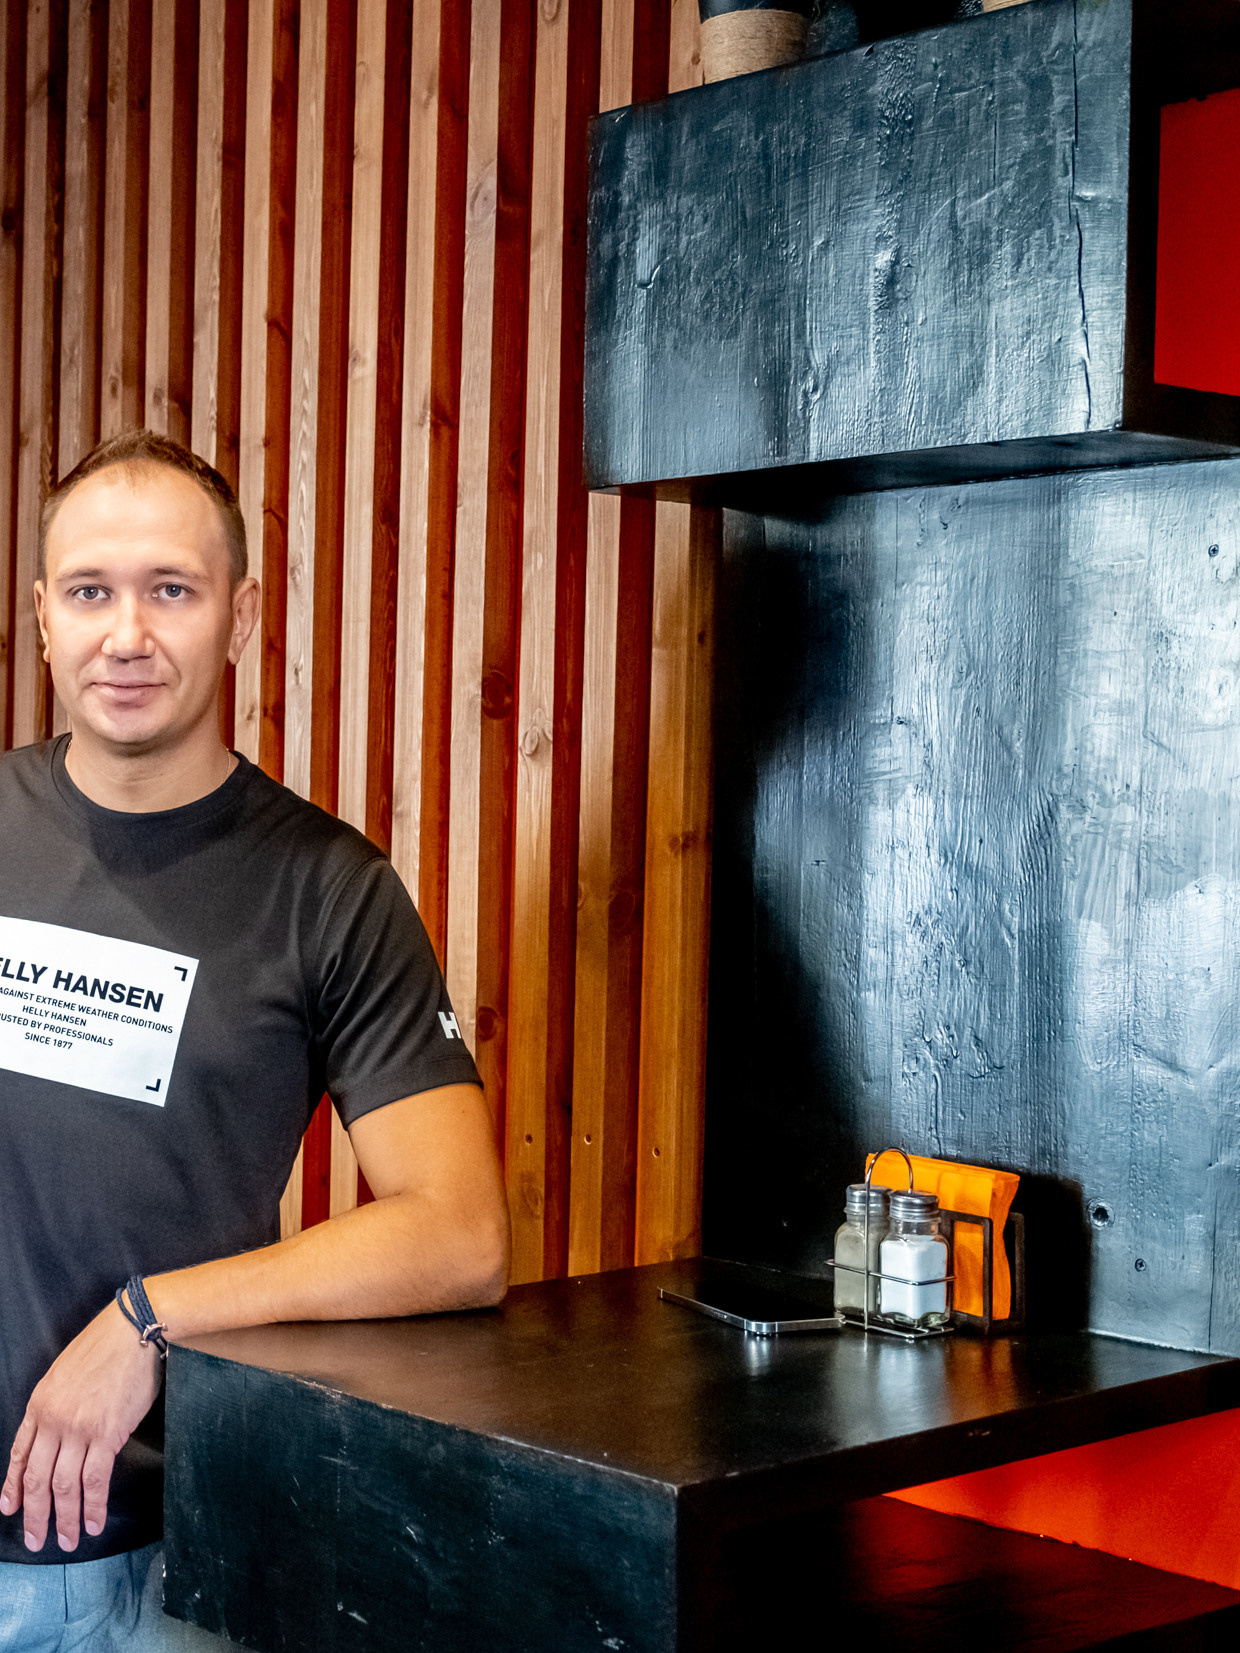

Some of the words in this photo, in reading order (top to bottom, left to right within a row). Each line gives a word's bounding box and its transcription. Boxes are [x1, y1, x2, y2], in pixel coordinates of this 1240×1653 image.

[53, 970, 164, 1012] HANSEN
[22, 1005, 50, 1019] HELLY
[51, 1011, 87, 1027] HANSEN
[36, 995, 76, 1011] EXTREME
[78, 1005, 119, 1021] WEATHER
[121, 1016, 173, 1034] CONDITIONS
[25, 1032, 50, 1045] SINCE
[53, 1038, 73, 1050] 1877
[31, 1020, 43, 1029] BY
[44, 1023, 113, 1047] PROFESSIONALS
